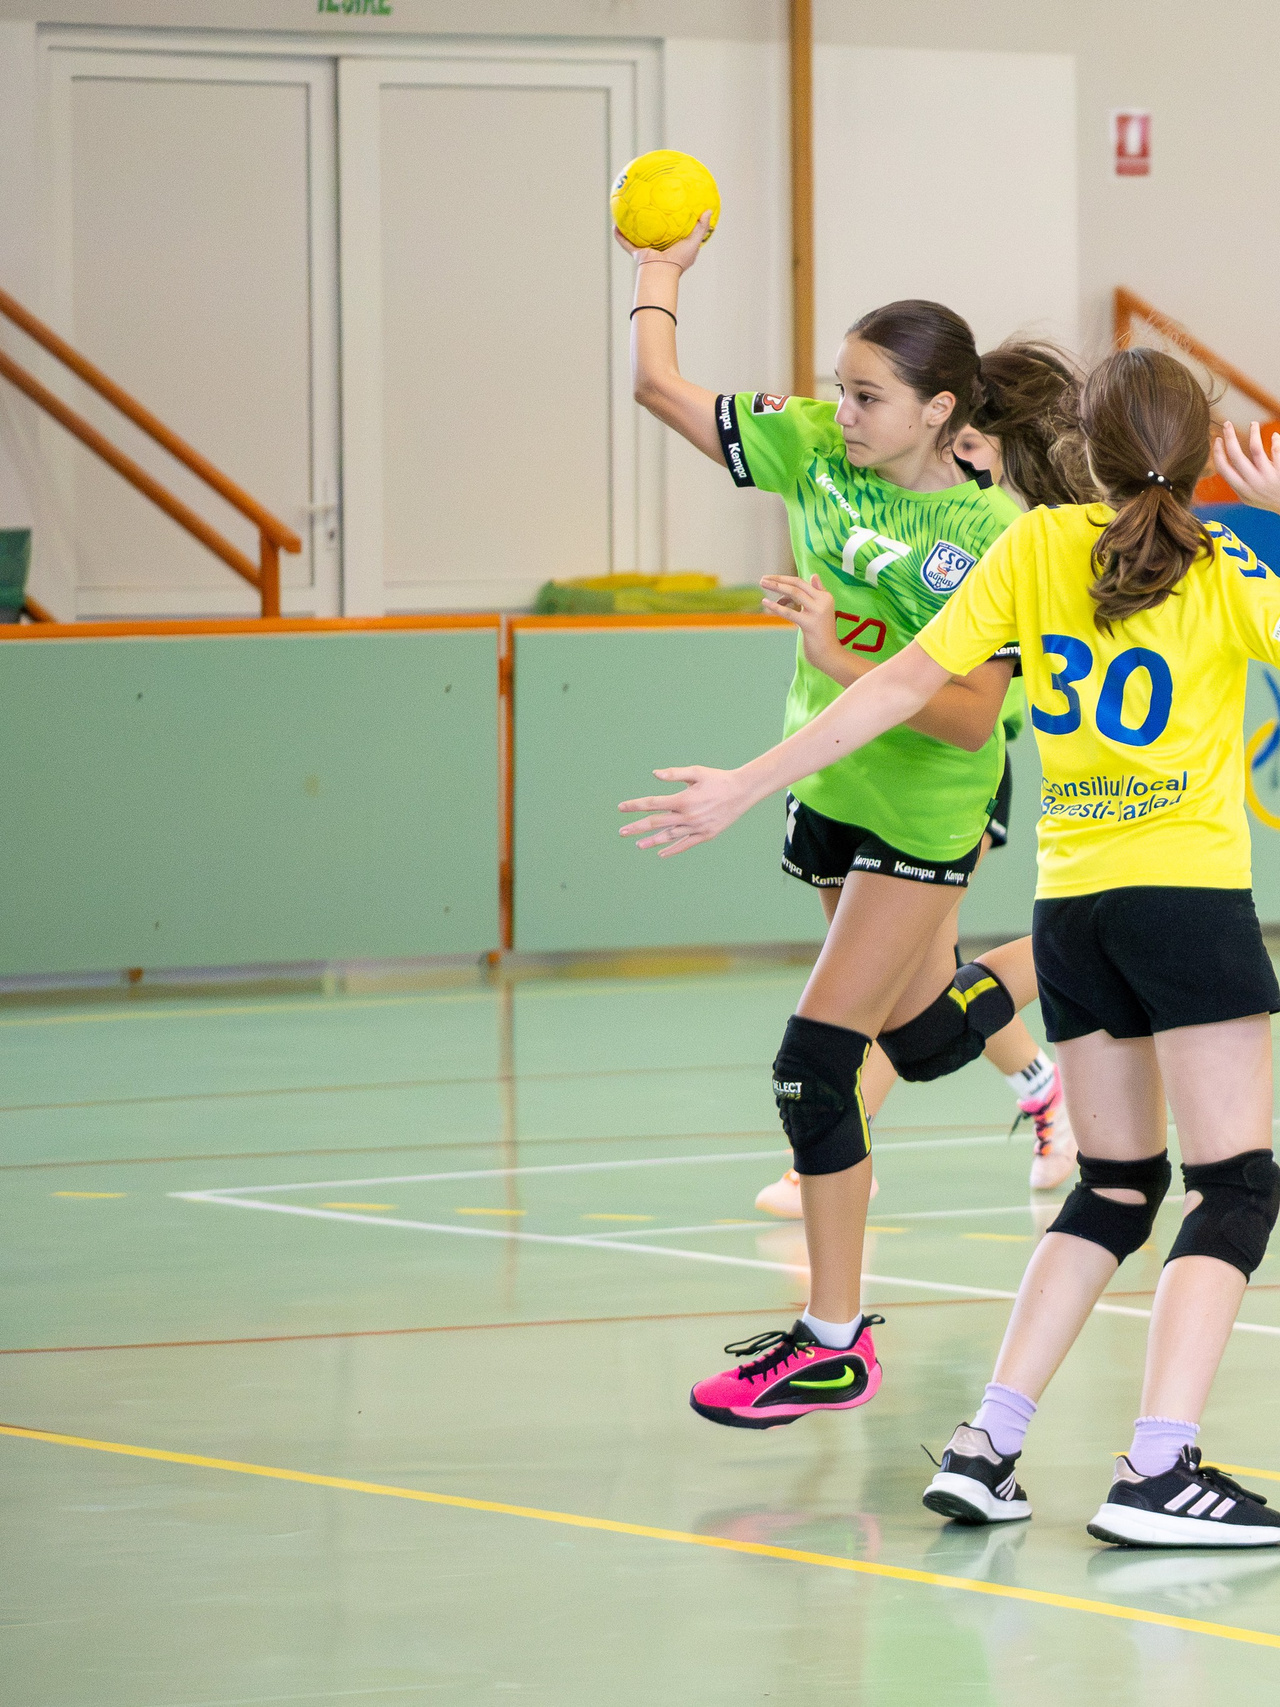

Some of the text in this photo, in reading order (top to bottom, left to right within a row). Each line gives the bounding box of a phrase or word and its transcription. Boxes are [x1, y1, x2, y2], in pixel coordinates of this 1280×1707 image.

[728, 442, 748, 479] Kempa
[815, 473, 861, 520] Kempa
[842, 525, 913, 587] 17
[937, 547, 968, 571] CSO
[1031, 634, 1174, 747] 30
[1041, 770, 1188, 798] Consiliul local
[853, 854, 965, 885] Kempa Kempa Kempa
